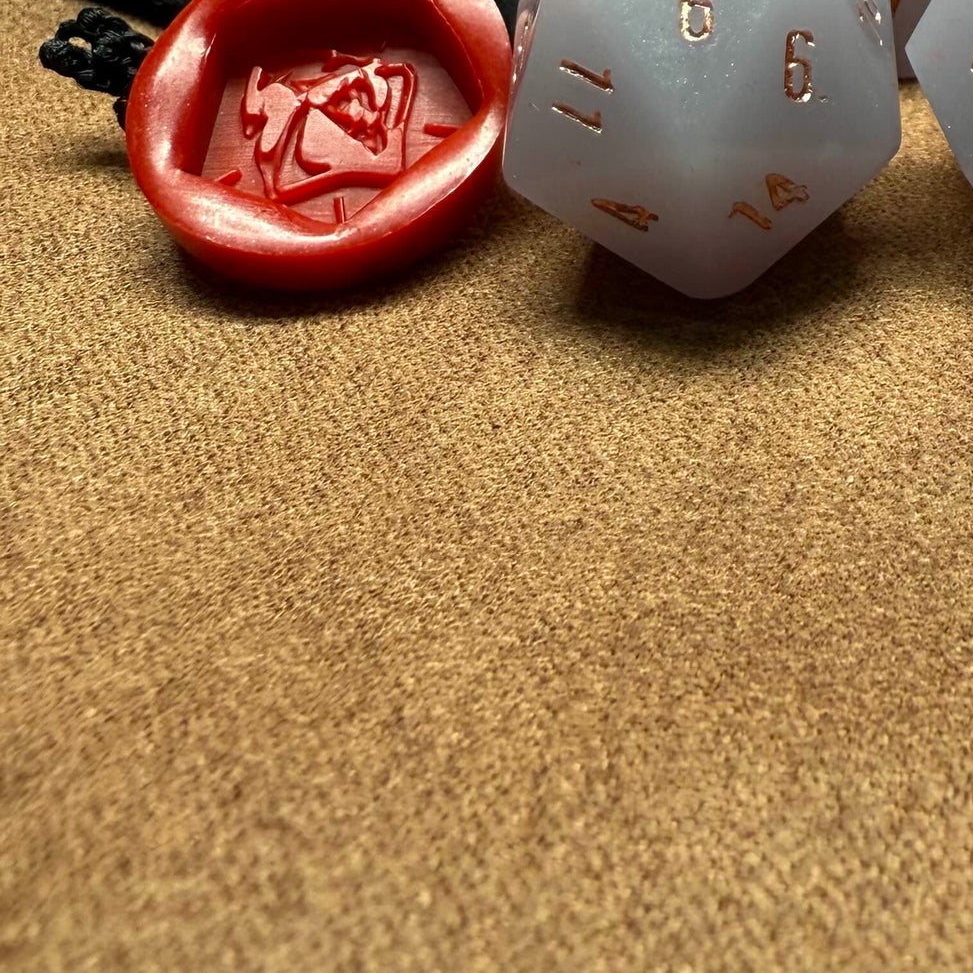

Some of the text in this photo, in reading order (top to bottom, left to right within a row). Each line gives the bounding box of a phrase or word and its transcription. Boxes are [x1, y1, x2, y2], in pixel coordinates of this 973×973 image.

[551, 58, 616, 134] 11
[589, 197, 660, 232] 4
[728, 172, 811, 231] 14
